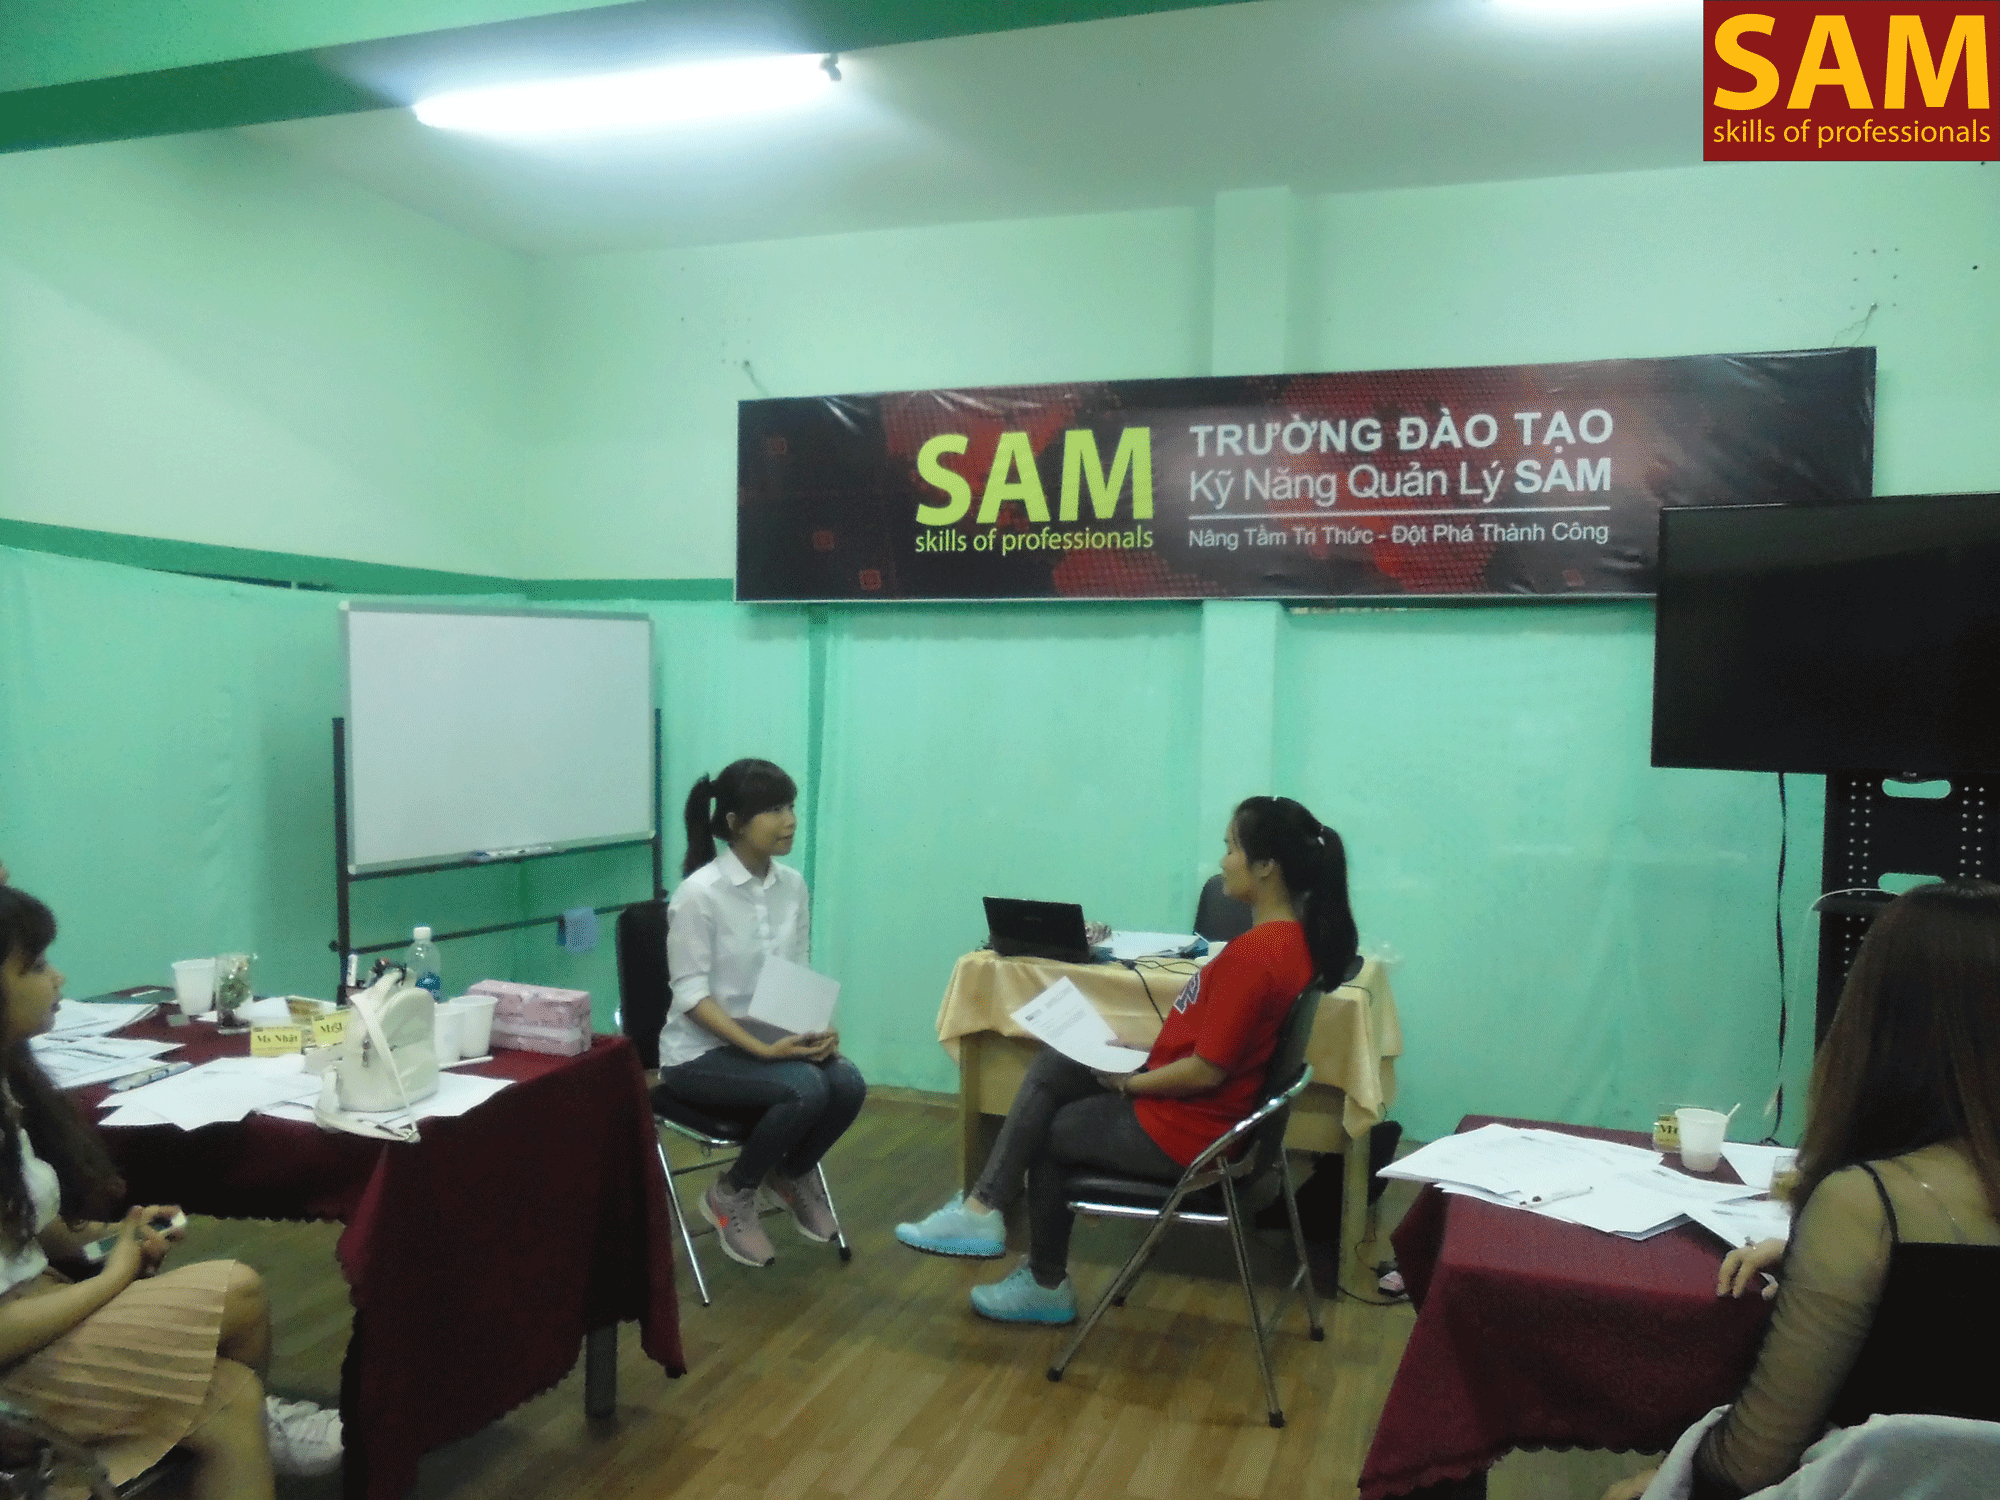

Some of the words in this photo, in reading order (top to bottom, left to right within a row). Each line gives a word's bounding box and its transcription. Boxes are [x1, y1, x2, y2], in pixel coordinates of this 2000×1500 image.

[1189, 413, 1382, 457] TRƯỜNG
[1396, 407, 1498, 450] ĐÀO
[1514, 408, 1614, 453] TẠO
[916, 426, 1154, 526] SAM
[1190, 468, 1235, 510] Kỹ
[1245, 466, 1337, 508] Năng
[1348, 461, 1448, 499] Quản
[1459, 460, 1504, 503] Lý
[1515, 457, 1611, 493] SAM
[915, 529, 967, 552] skills
[973, 528, 998, 551] of
[1002, 524, 1154, 556] professionals
[1189, 529, 1240, 551] Nâng
[1244, 524, 1288, 546] Tầm
[1321, 525, 1374, 545] Thức
[1391, 525, 1428, 546] Đột
[1433, 524, 1474, 543] Phá
[1479, 522, 1545, 542] Thành
[1551, 521, 1609, 545] Công
